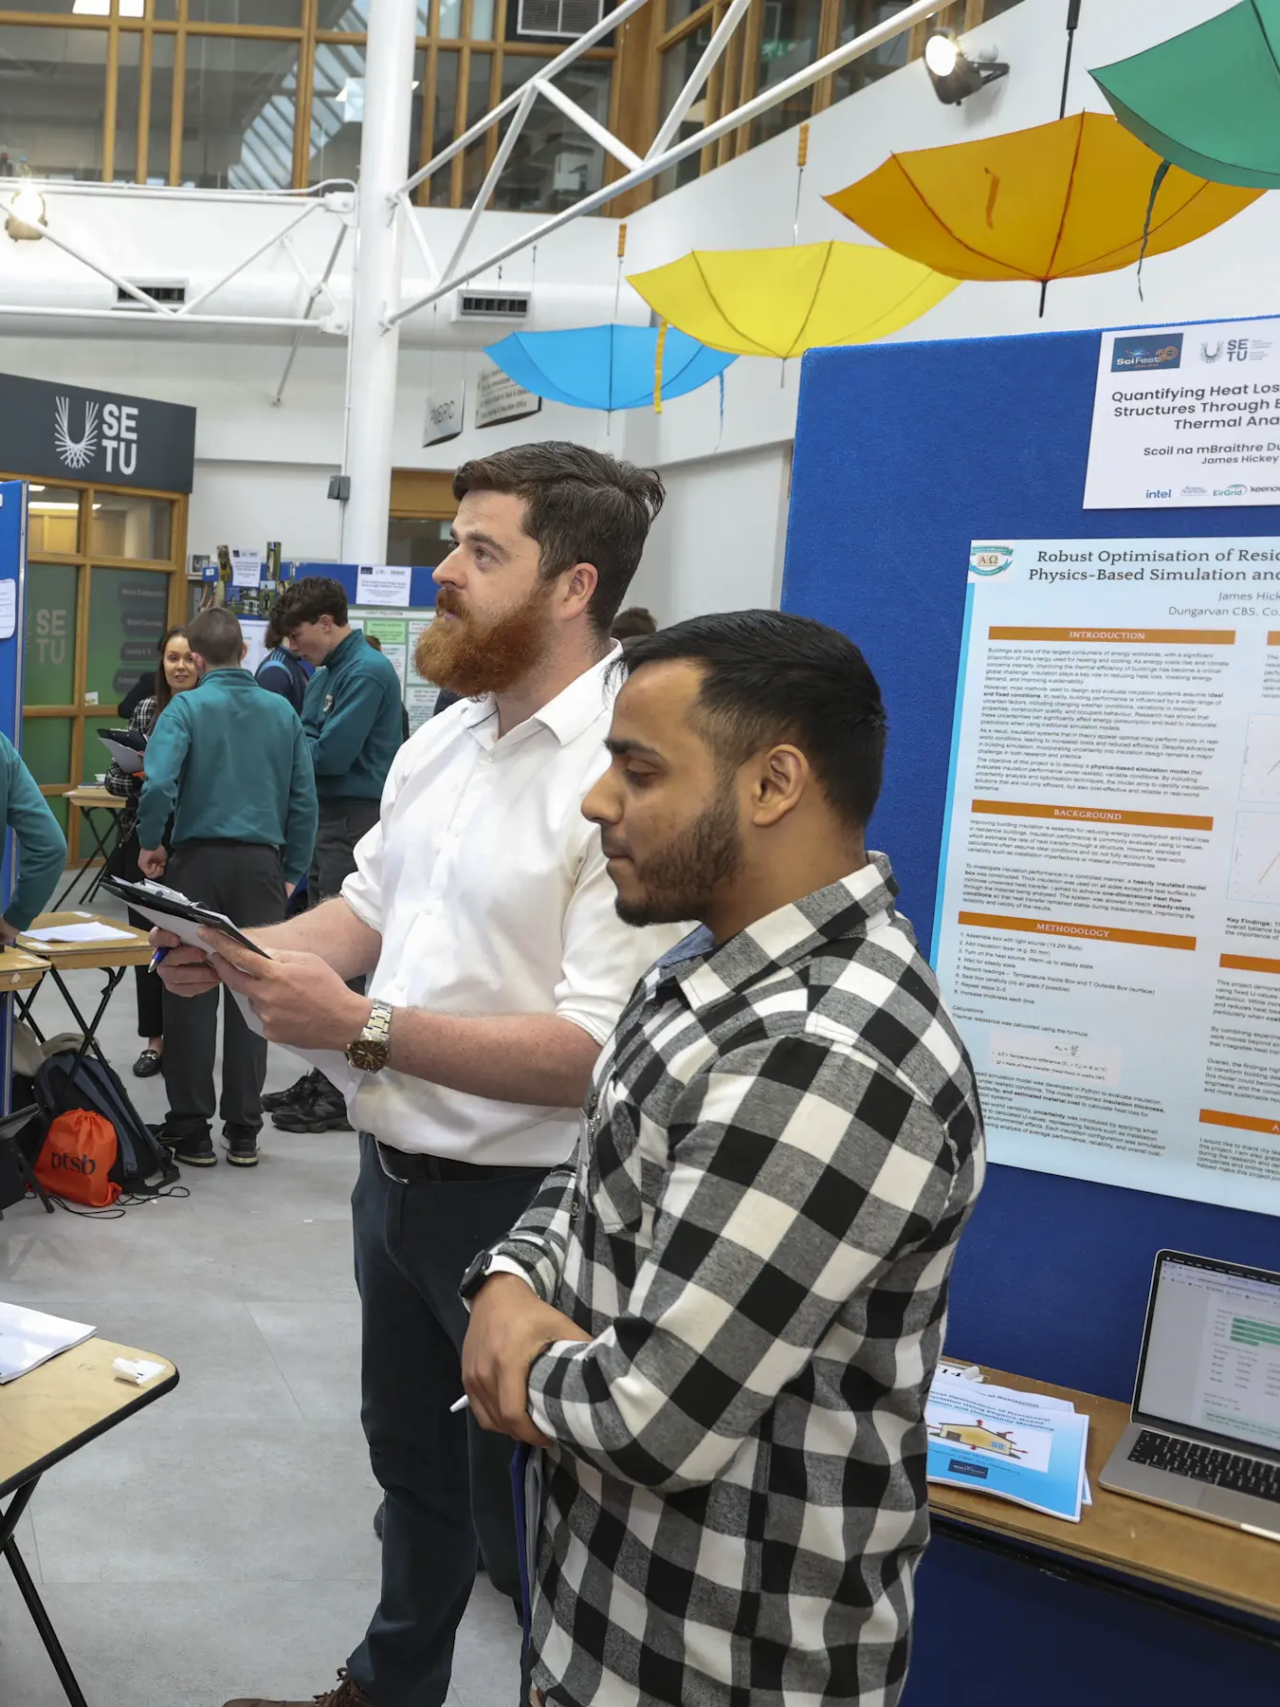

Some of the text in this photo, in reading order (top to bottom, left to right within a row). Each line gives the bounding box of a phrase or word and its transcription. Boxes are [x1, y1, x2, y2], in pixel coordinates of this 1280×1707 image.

[1227, 339, 1249, 350] SE
[1117, 357, 1160, 365] SciFest
[1227, 351, 1247, 362] TU
[1112, 387, 1205, 402] Quantifying
[1210, 384, 1249, 396] Heat
[1114, 401, 1269, 417] Structures Through
[102, 403, 139, 439] SE
[1174, 417, 1242, 429] Thermal
[1144, 446, 1173, 456] Scoil
[1197, 444, 1263, 454] mBraithre
[101, 439, 137, 474] TU
[1201, 455, 1279, 465] James Hickey
[1146, 490, 1172, 498] intel
[1037, 551, 1093, 563] Robust
[1098, 551, 1210, 565] Optimisation
[1215, 549, 1234, 562] of
[1028, 569, 1144, 583] Physics-Based
[1150, 569, 1246, 581] Simulation
[1219, 592, 1252, 602] James
[1169, 607, 1229, 618] Dungarvan
[36, 609, 66, 635] SE
[1070, 631, 1145, 640] INTRODUCTION
[36, 639, 65, 665] TU
[1054, 809, 1122, 820] BACKGROUND
[1036, 922, 1110, 938] METHODOLOGY
[51, 1152, 96, 1175] ptsb
